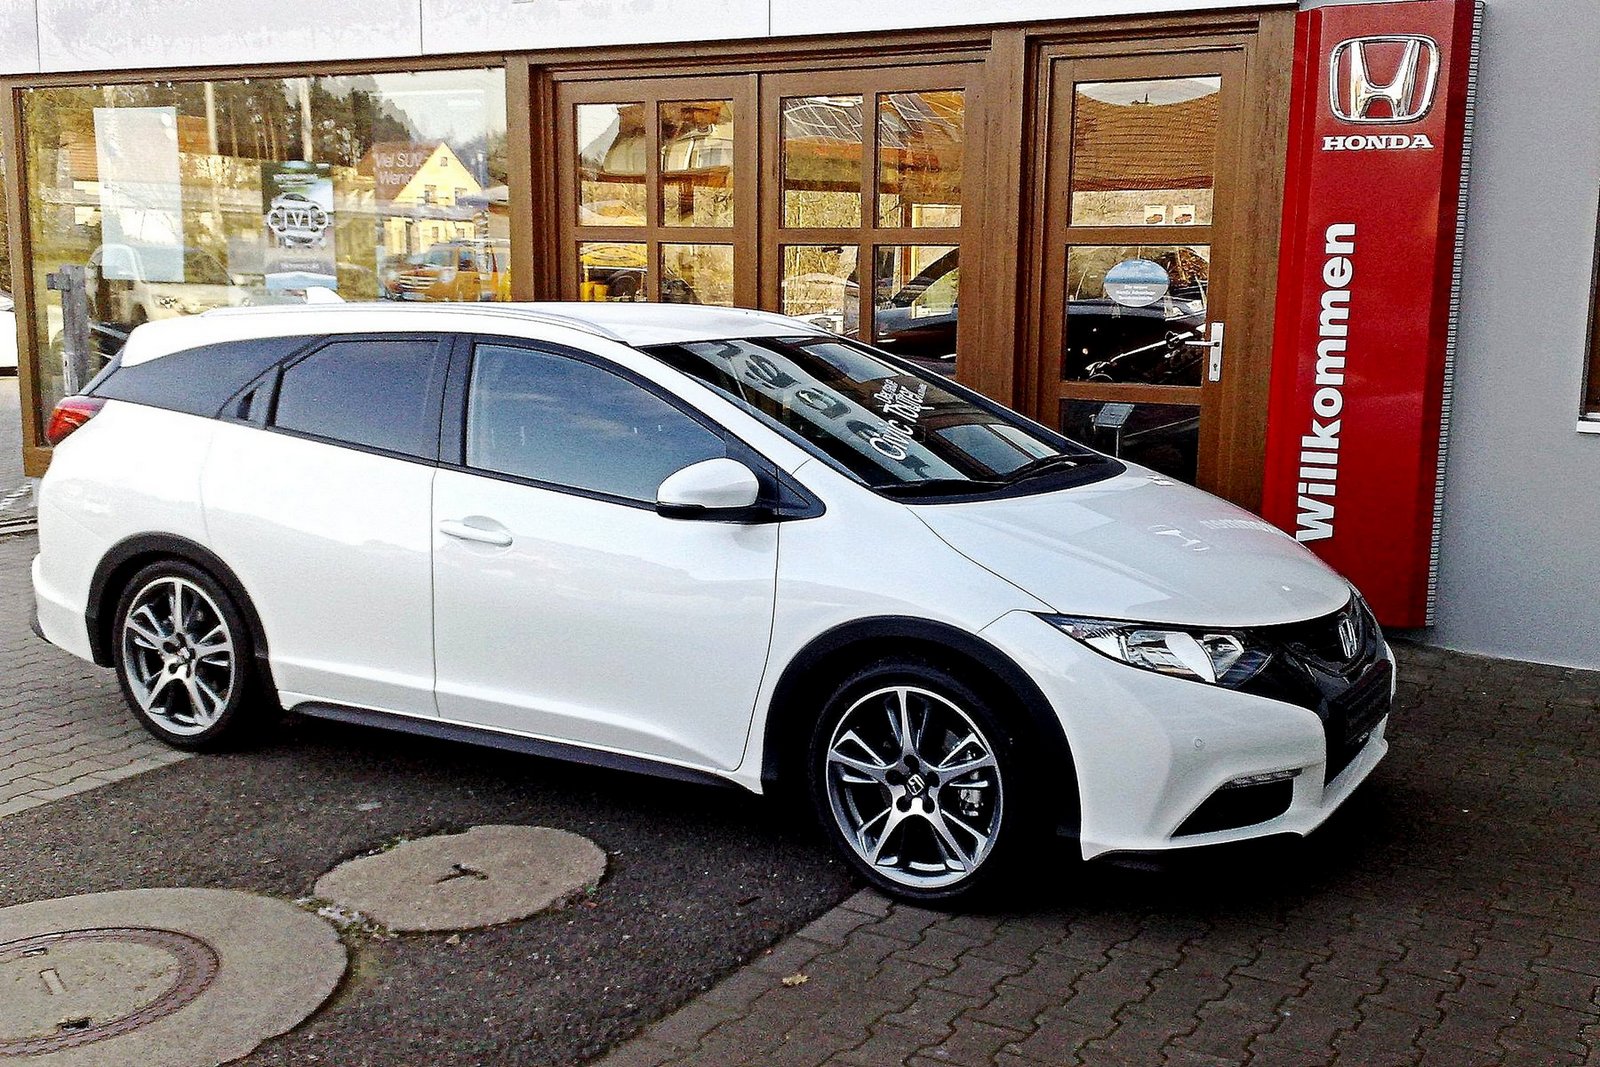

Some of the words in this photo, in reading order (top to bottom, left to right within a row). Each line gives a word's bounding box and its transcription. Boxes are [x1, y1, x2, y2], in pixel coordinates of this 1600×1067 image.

[1321, 134, 1434, 151] HONDA
[1295, 222, 1356, 542] Willkommen
[869, 419, 914, 460] Civic
